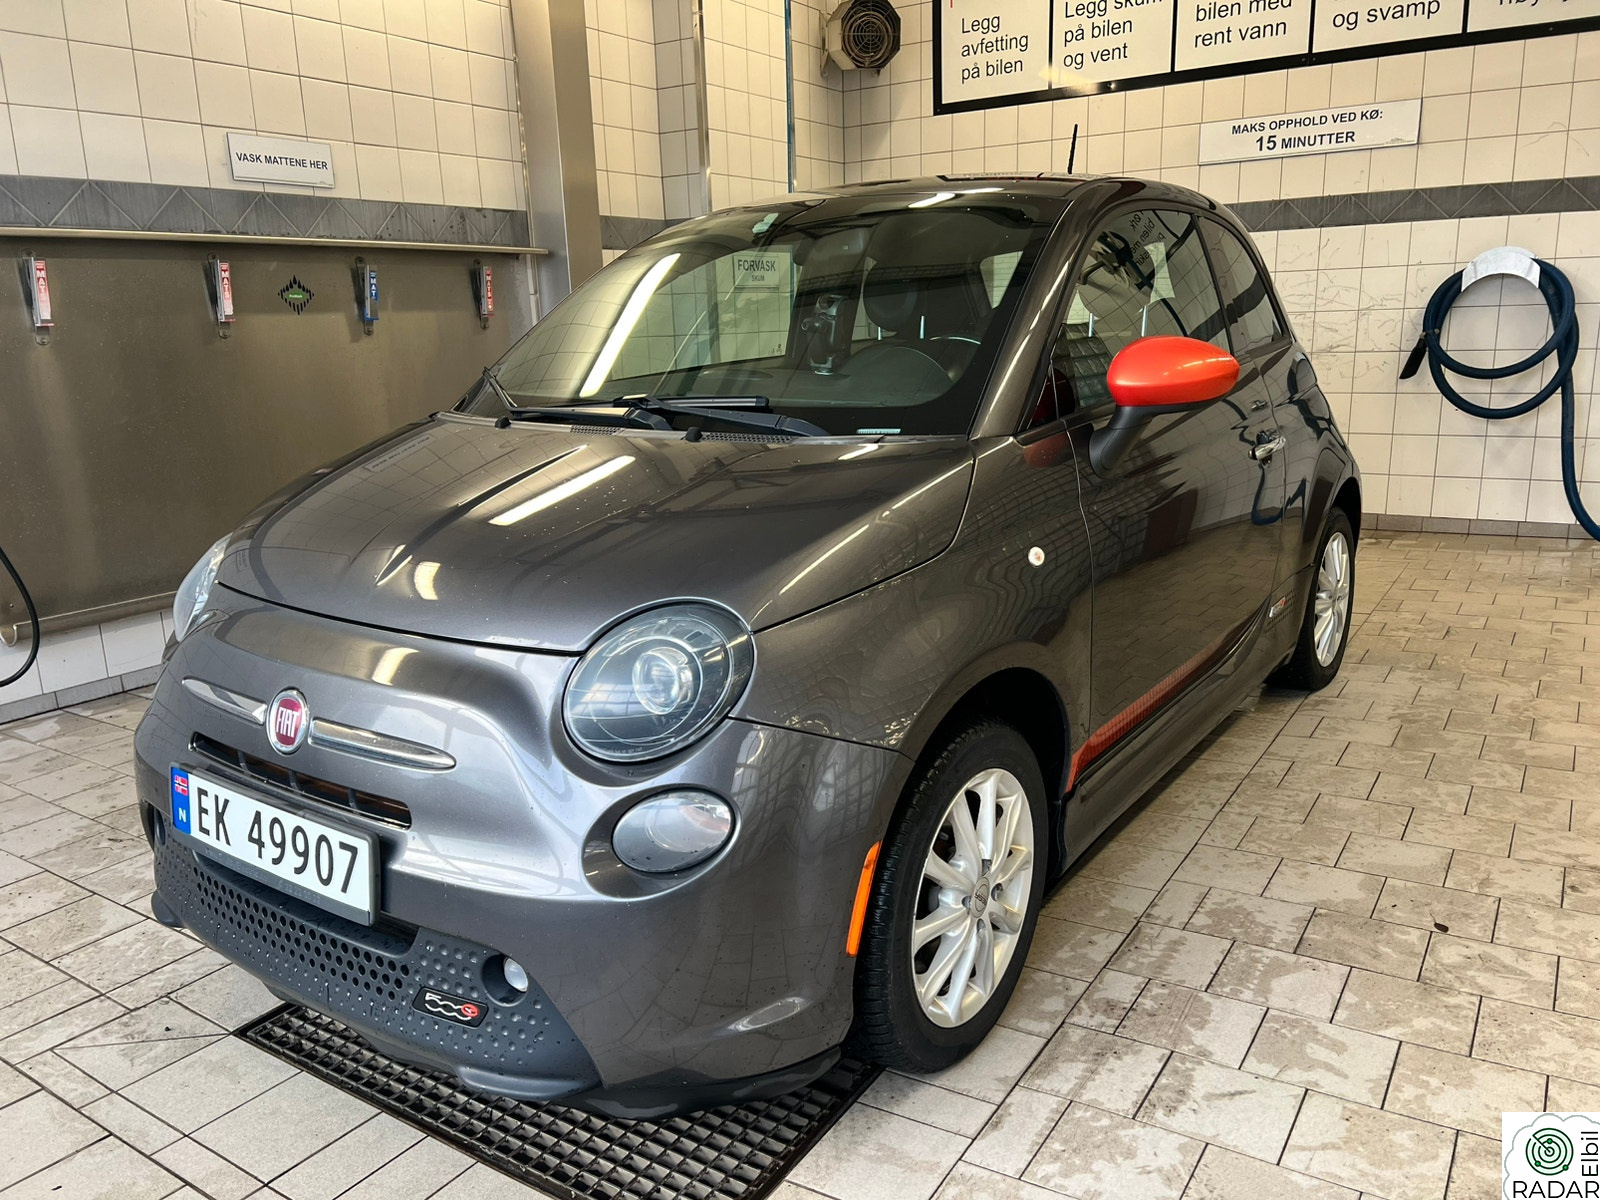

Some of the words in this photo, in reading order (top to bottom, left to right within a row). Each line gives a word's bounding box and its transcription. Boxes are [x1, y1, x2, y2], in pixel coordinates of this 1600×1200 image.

[1064, 0, 1108, 20] Legg
[1196, 1, 1241, 22] bilen
[1332, 11, 1359, 31] og
[1366, 0, 1441, 23] svamp
[961, 15, 1001, 34] Legg
[1064, 23, 1086, 47] på
[1091, 19, 1133, 39] bilen
[1194, 26, 1232, 48] rent
[1238, 21, 1287, 41] vann
[961, 34, 1029, 57] avfetting
[1063, 51, 1085, 70] og
[1090, 42, 1129, 63] vent
[961, 62, 981, 84] på
[986, 59, 1023, 77] bilen
[1231, 122, 1266, 135] MAKS
[1269, 115, 1328, 131] OPPHOLD
[1332, 110, 1357, 124] VED
[1360, 109, 1384, 121] KØ:
[1255, 135, 1277, 152] 15
[1281, 131, 1356, 150] MINUTTER
[235, 152, 262, 164] VASK
[264, 155, 308, 168] MATTENE
[309, 160, 329, 170] HER
[737, 259, 776, 272] FORVASK
[276, 706, 300, 738] FIAT
[178, 807, 187, 823] N
[197, 787, 231, 847] EK
[247, 810, 359, 894] 49907
